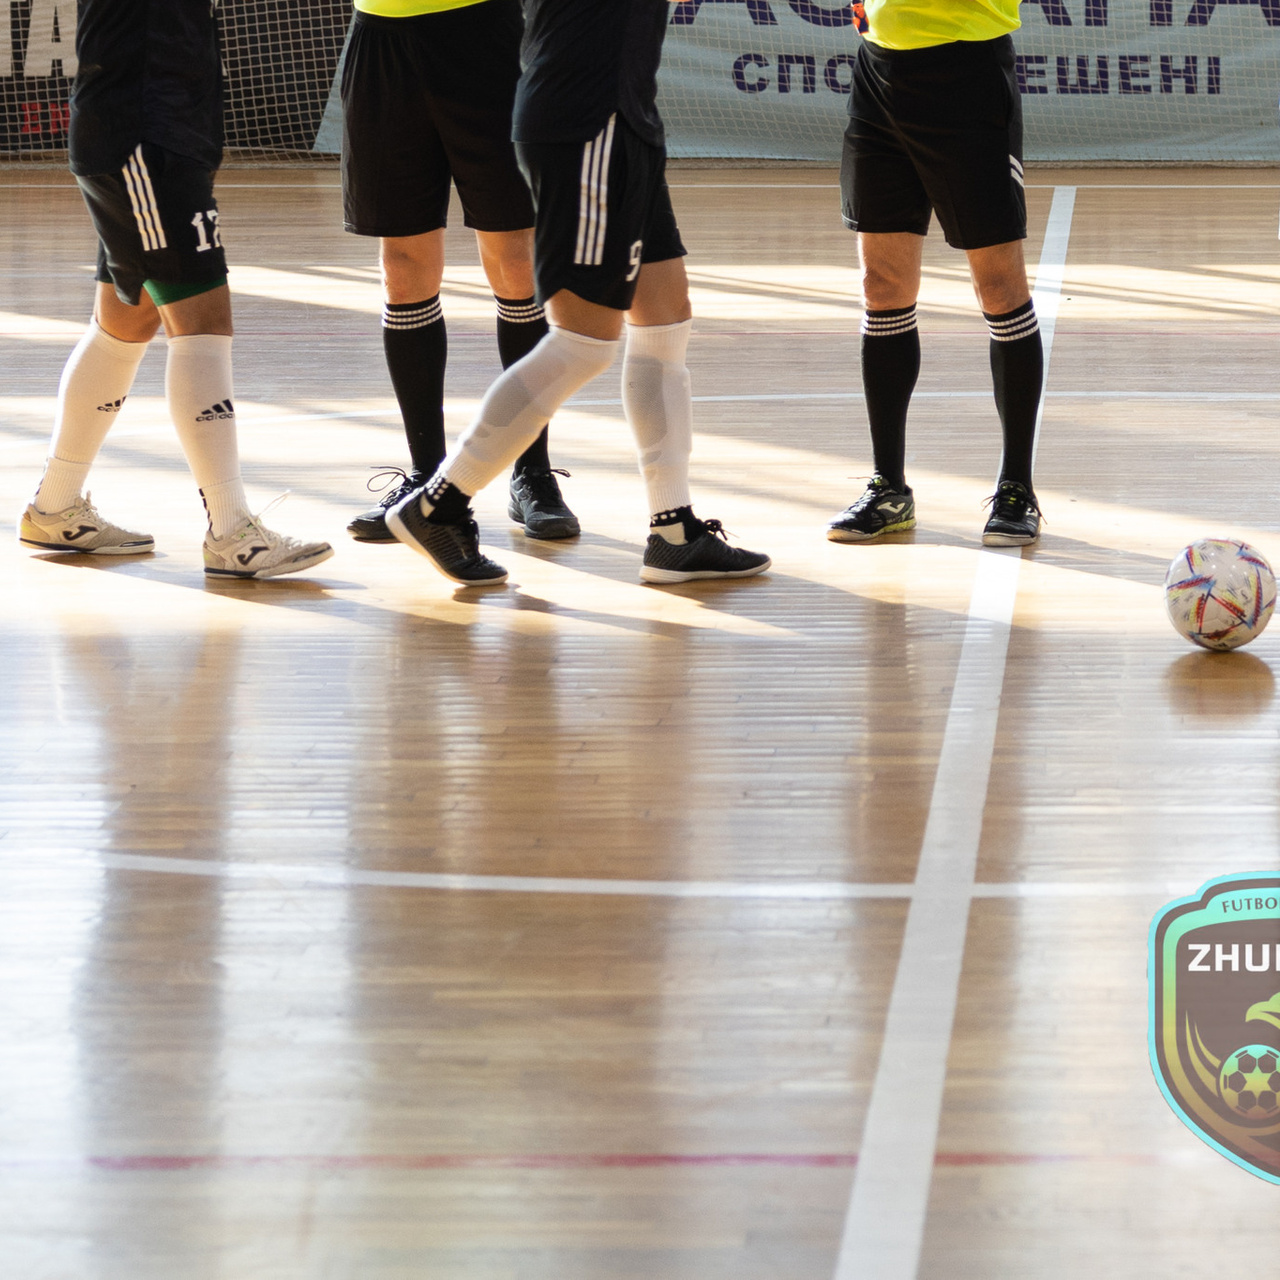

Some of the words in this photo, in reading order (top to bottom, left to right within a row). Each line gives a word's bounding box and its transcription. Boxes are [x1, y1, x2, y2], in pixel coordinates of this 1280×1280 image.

[731, 53, 853, 95] СПО
[1017, 54, 1221, 95] ЕШЕНІ
[626, 239, 643, 281] 9
